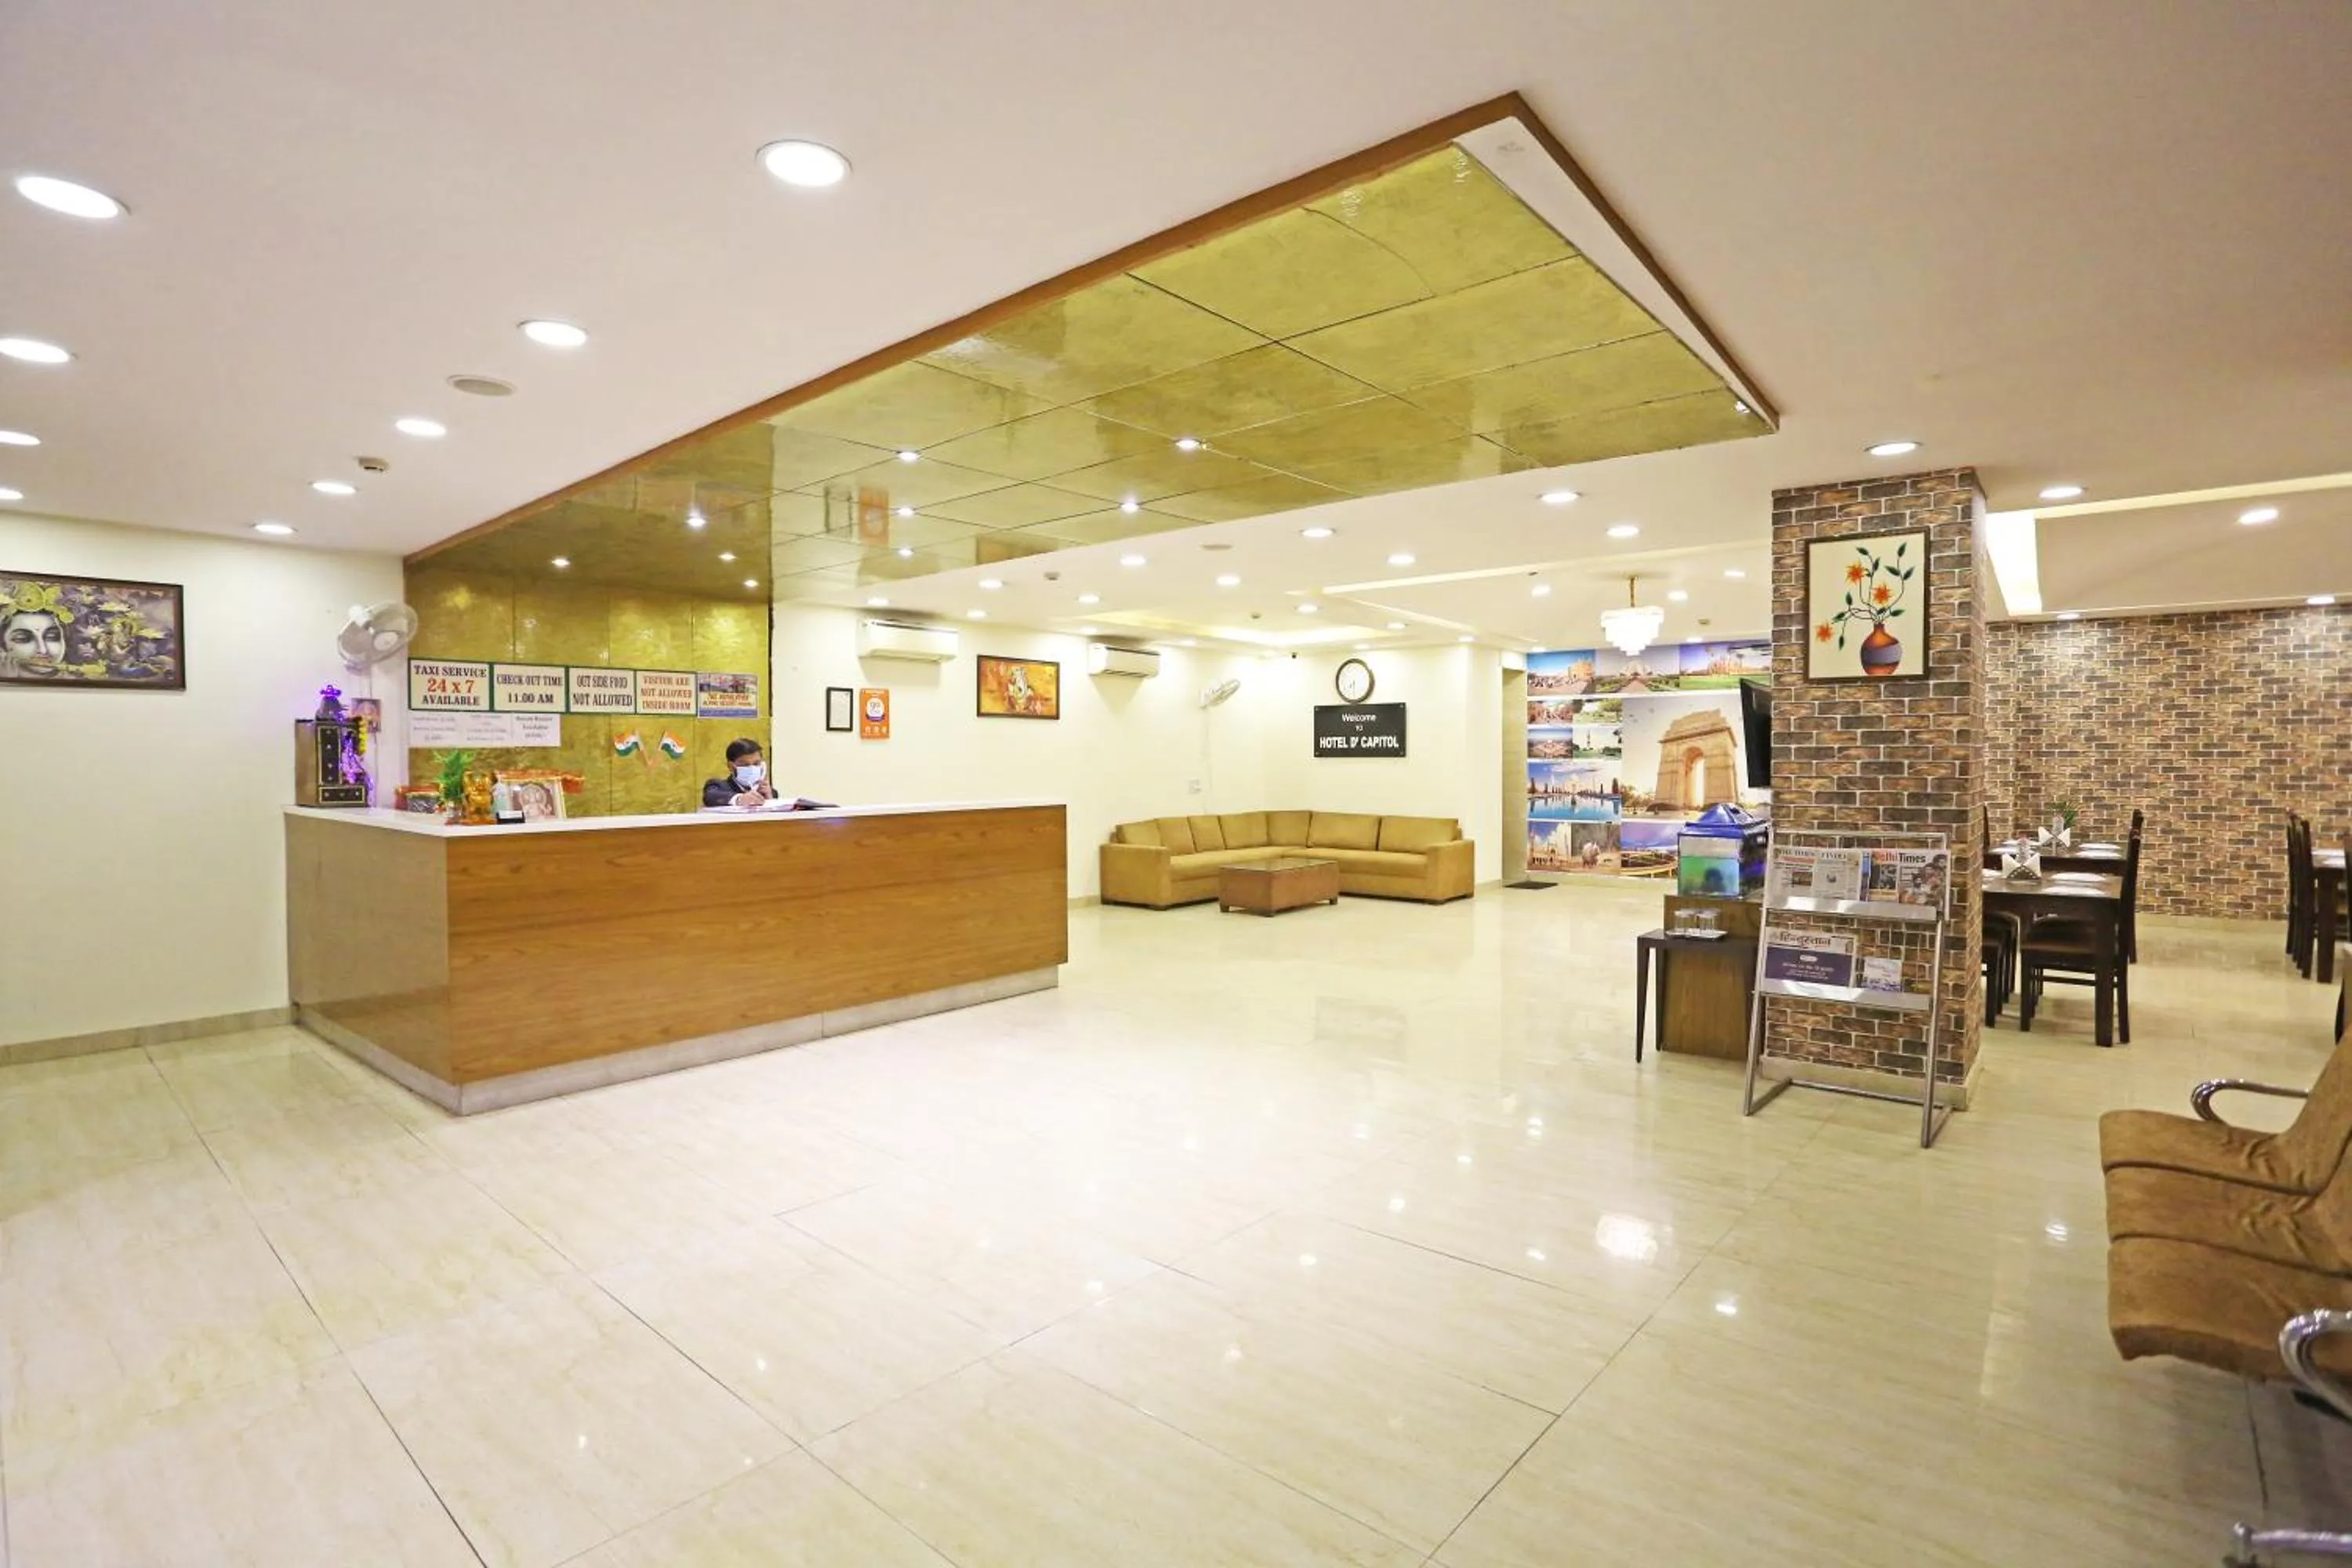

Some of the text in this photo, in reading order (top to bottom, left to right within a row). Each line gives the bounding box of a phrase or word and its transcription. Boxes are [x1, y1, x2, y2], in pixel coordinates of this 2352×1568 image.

[414, 665, 487, 678] TAXI SERVICE
[427, 677, 448, 692] 24
[465, 680, 474, 693] 7
[496, 674, 563, 687] CHECK OUT TIME
[576, 674, 628, 689] OUT SIDE FOOD
[508, 692, 554, 704] 11.00 AM
[573, 693, 633, 706] NOT ALLOWED
[659, 688, 692, 699] ALLOWED
[422, 695, 481, 706] AVAILABLE
[1341, 713, 1377, 722] Welcome
[1319, 737, 1348, 748] HOTEL
[1360, 735, 1399, 747] CAPITOL
[1899, 852, 1926, 863] Times
